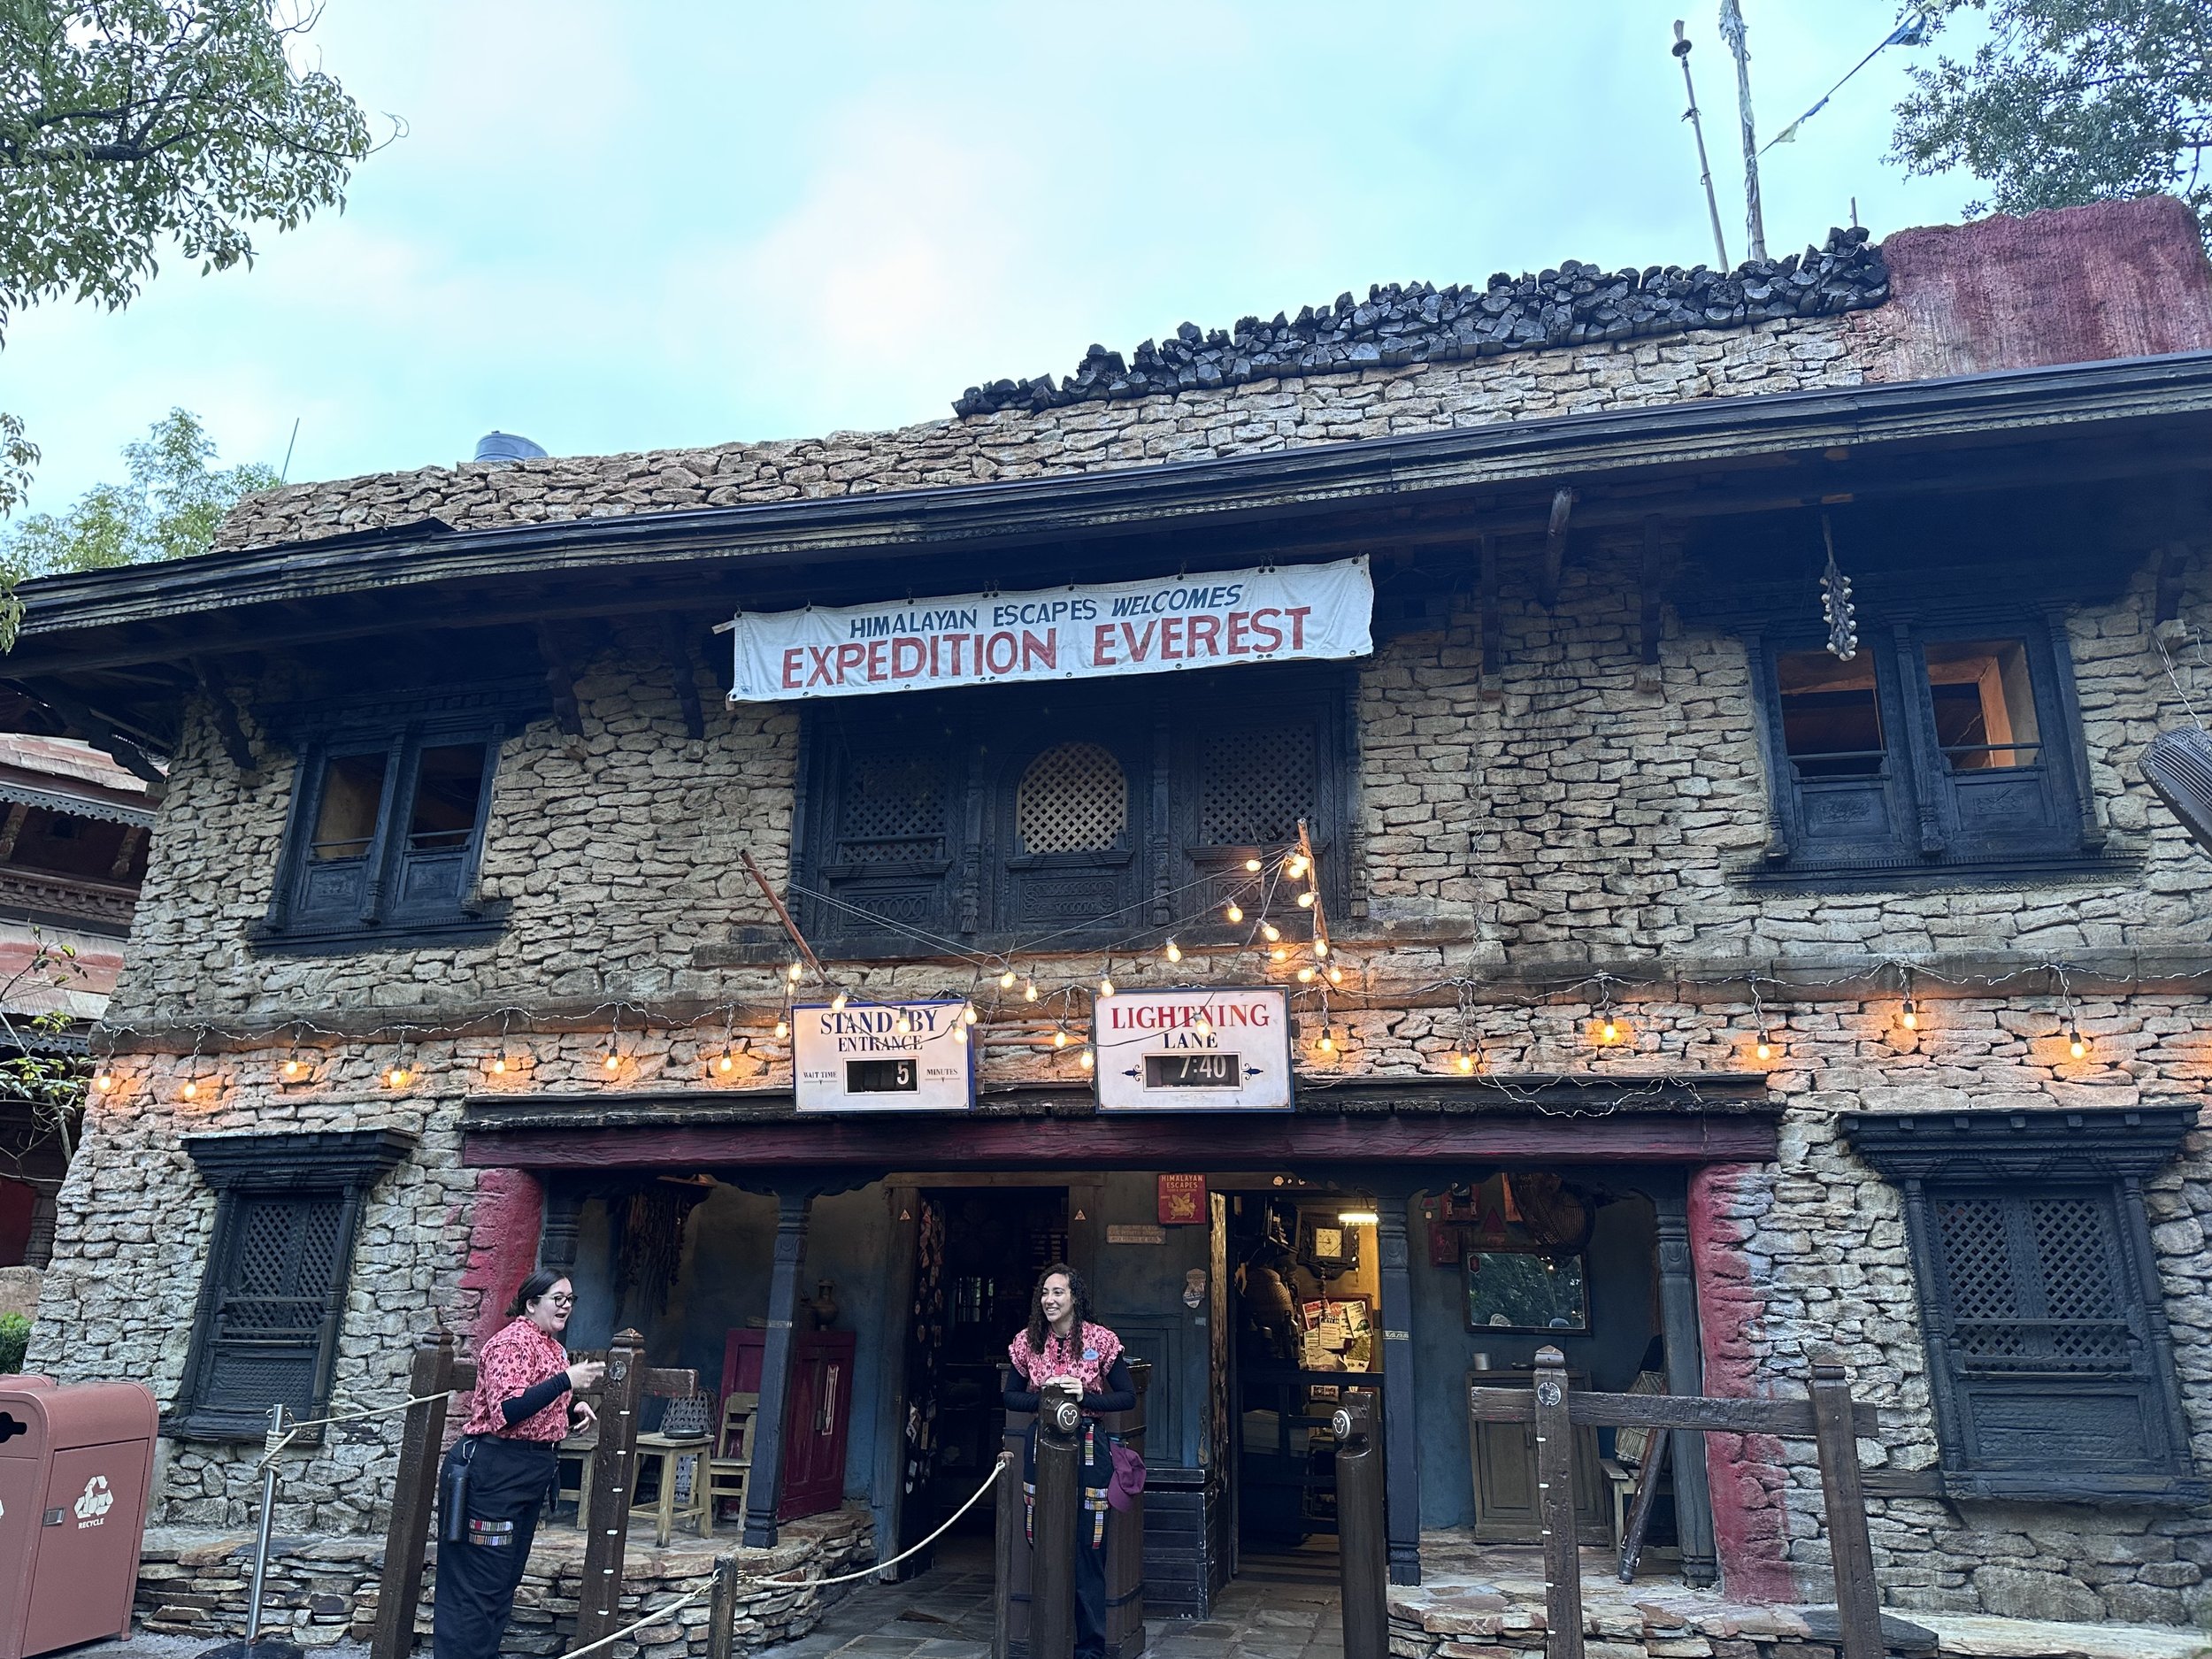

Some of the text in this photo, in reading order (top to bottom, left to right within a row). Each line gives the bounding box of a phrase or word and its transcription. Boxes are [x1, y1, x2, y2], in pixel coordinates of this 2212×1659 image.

[849, 584, 1244, 639] HIMALAYAN ESCAPES WELCOMES
[781, 605, 1312, 690] EXPEDITION EVEREST
[1111, 1003, 1270, 1029] LIGHTNING
[838, 1034, 924, 1052] ENTRANCE
[1164, 1032, 1218, 1049] LANE
[896, 1061, 910, 1086] 5
[1179, 1055, 1227, 1079] 7:40
[78, 1517, 104, 1530] RECYCLE
